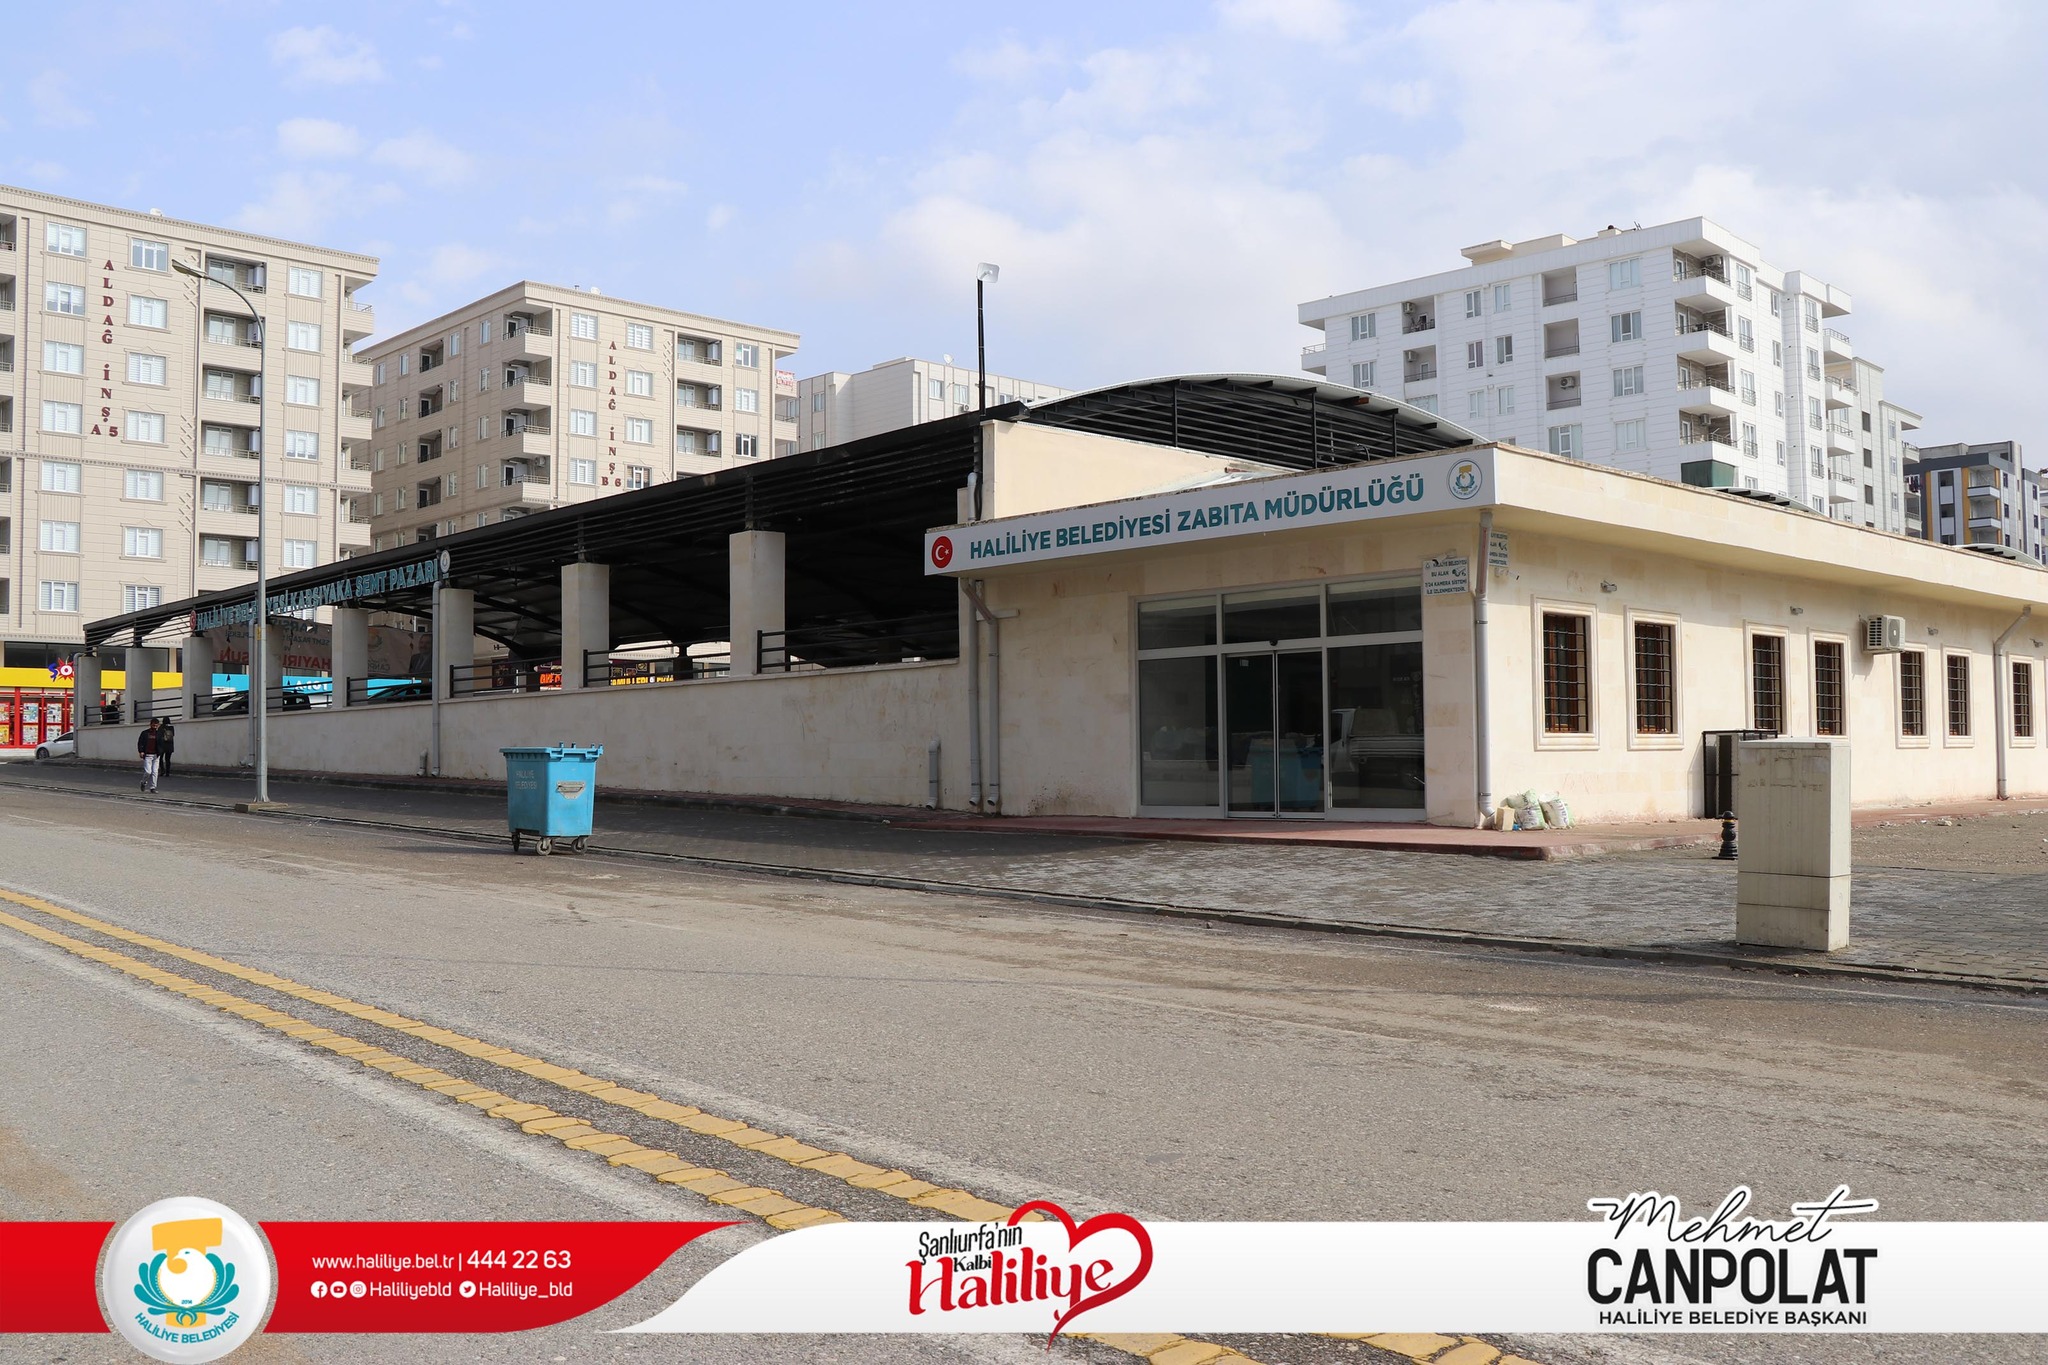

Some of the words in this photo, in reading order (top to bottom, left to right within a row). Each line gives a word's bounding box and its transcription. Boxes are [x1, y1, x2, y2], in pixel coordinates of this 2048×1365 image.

[102, 259, 114, 344] ALDAĞ
[608, 341, 617, 410] ALDAĞ
[91, 424, 102, 436] A
[109, 426, 119, 437] 5
[601, 476, 609, 486] B
[614, 478, 622, 487] 6
[970, 528, 1051, 560] HALİLİYE
[1056, 514, 1171, 548] BELEDİYESİ
[1178, 502, 1259, 532] ZABITA
[1265, 476, 1424, 520] MÜDÜRLÜĞÜ
[235, 590, 289, 623] BELEYESİ
[290, 579, 353, 609] KARŞIYAKA
[355, 571, 387, 597] SEMT
[390, 559, 438, 591] PAZARI
